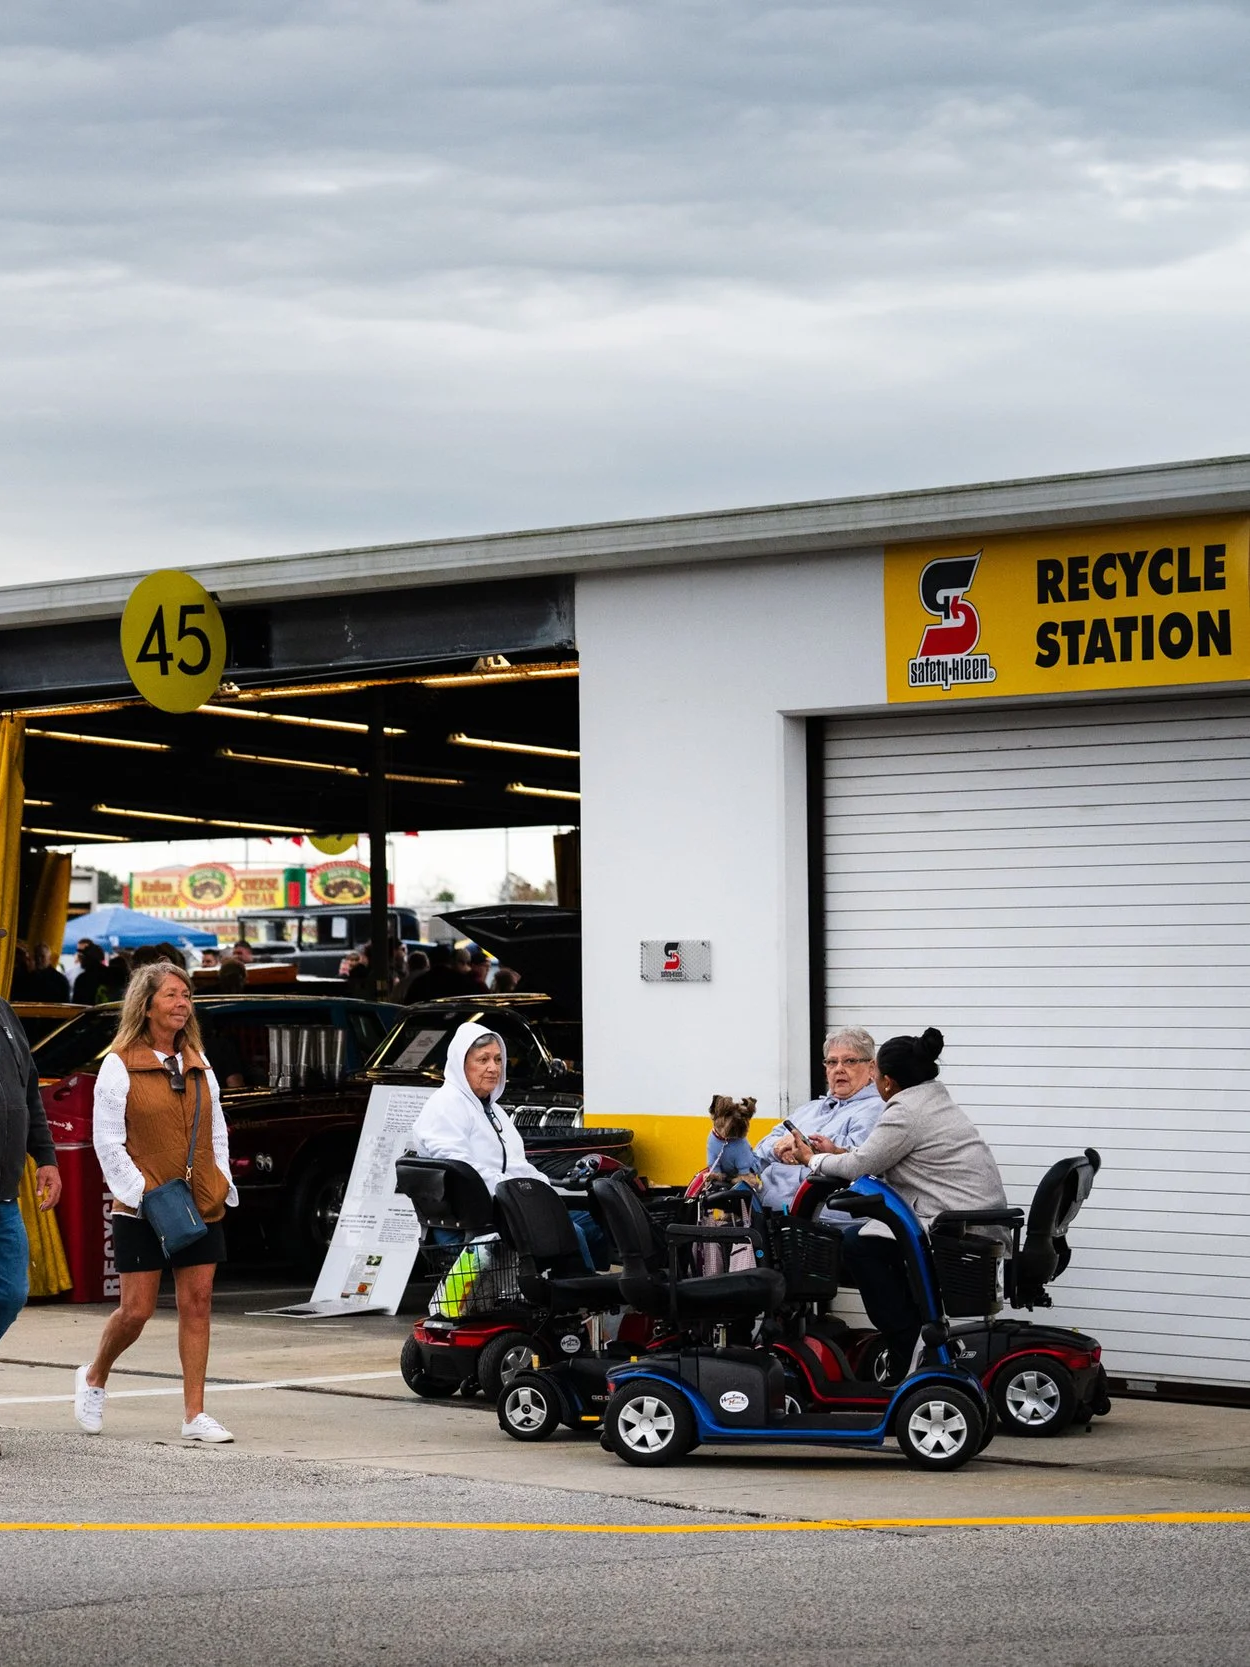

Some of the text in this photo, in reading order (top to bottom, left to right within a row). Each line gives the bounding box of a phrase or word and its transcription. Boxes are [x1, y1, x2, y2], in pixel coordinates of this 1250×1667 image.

[1036, 543, 1226, 605] RECYCLE
[135, 603, 212, 676] 45
[1035, 609, 1232, 668] STATION
